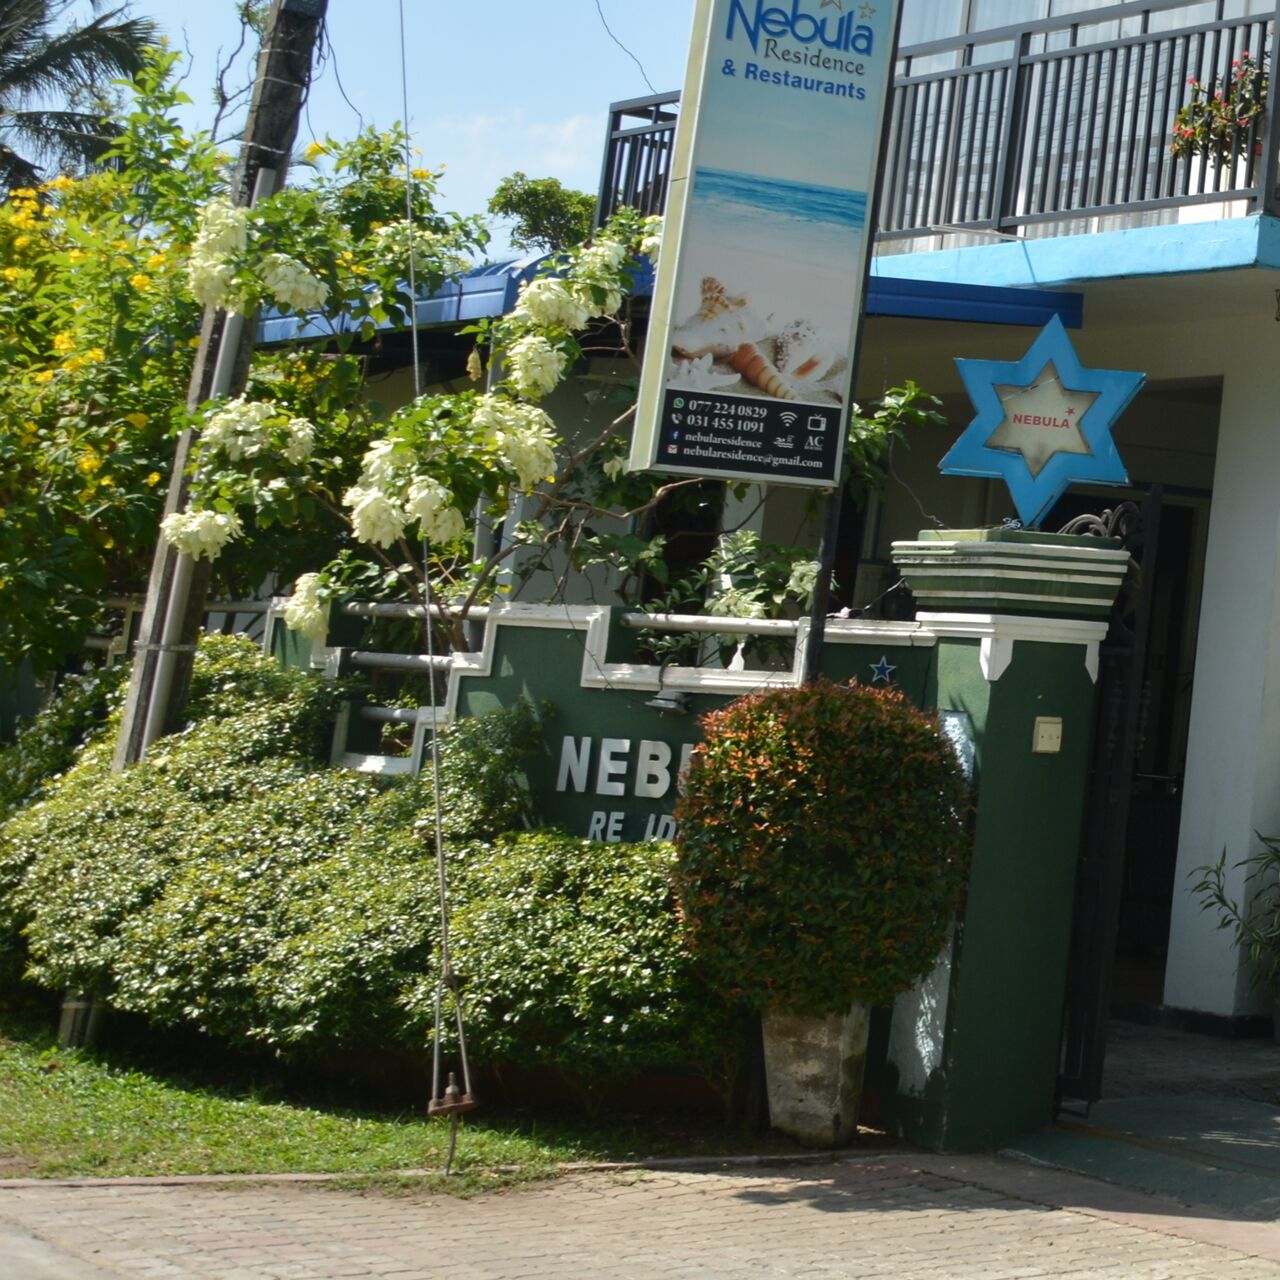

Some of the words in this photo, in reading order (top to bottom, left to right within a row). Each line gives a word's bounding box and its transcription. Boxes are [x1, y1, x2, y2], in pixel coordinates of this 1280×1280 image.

[764, 38, 866, 76] Residence
[721, 58, 737, 77] &
[744, 62, 867, 101] Restaurants
[689, 400, 713, 413] 077
[714, 402, 736, 416] 224
[737, 405, 768, 419] 0829
[687, 414, 709, 427] 031
[712, 417, 734, 429] 455
[737, 419, 765, 433] 1091
[1013, 413, 1070, 429] NEBULA
[685, 431, 763, 449] nebularesidence
[805, 435, 825, 448] AC
[683, 446, 824, 469] nebularesidence@gmail.com
